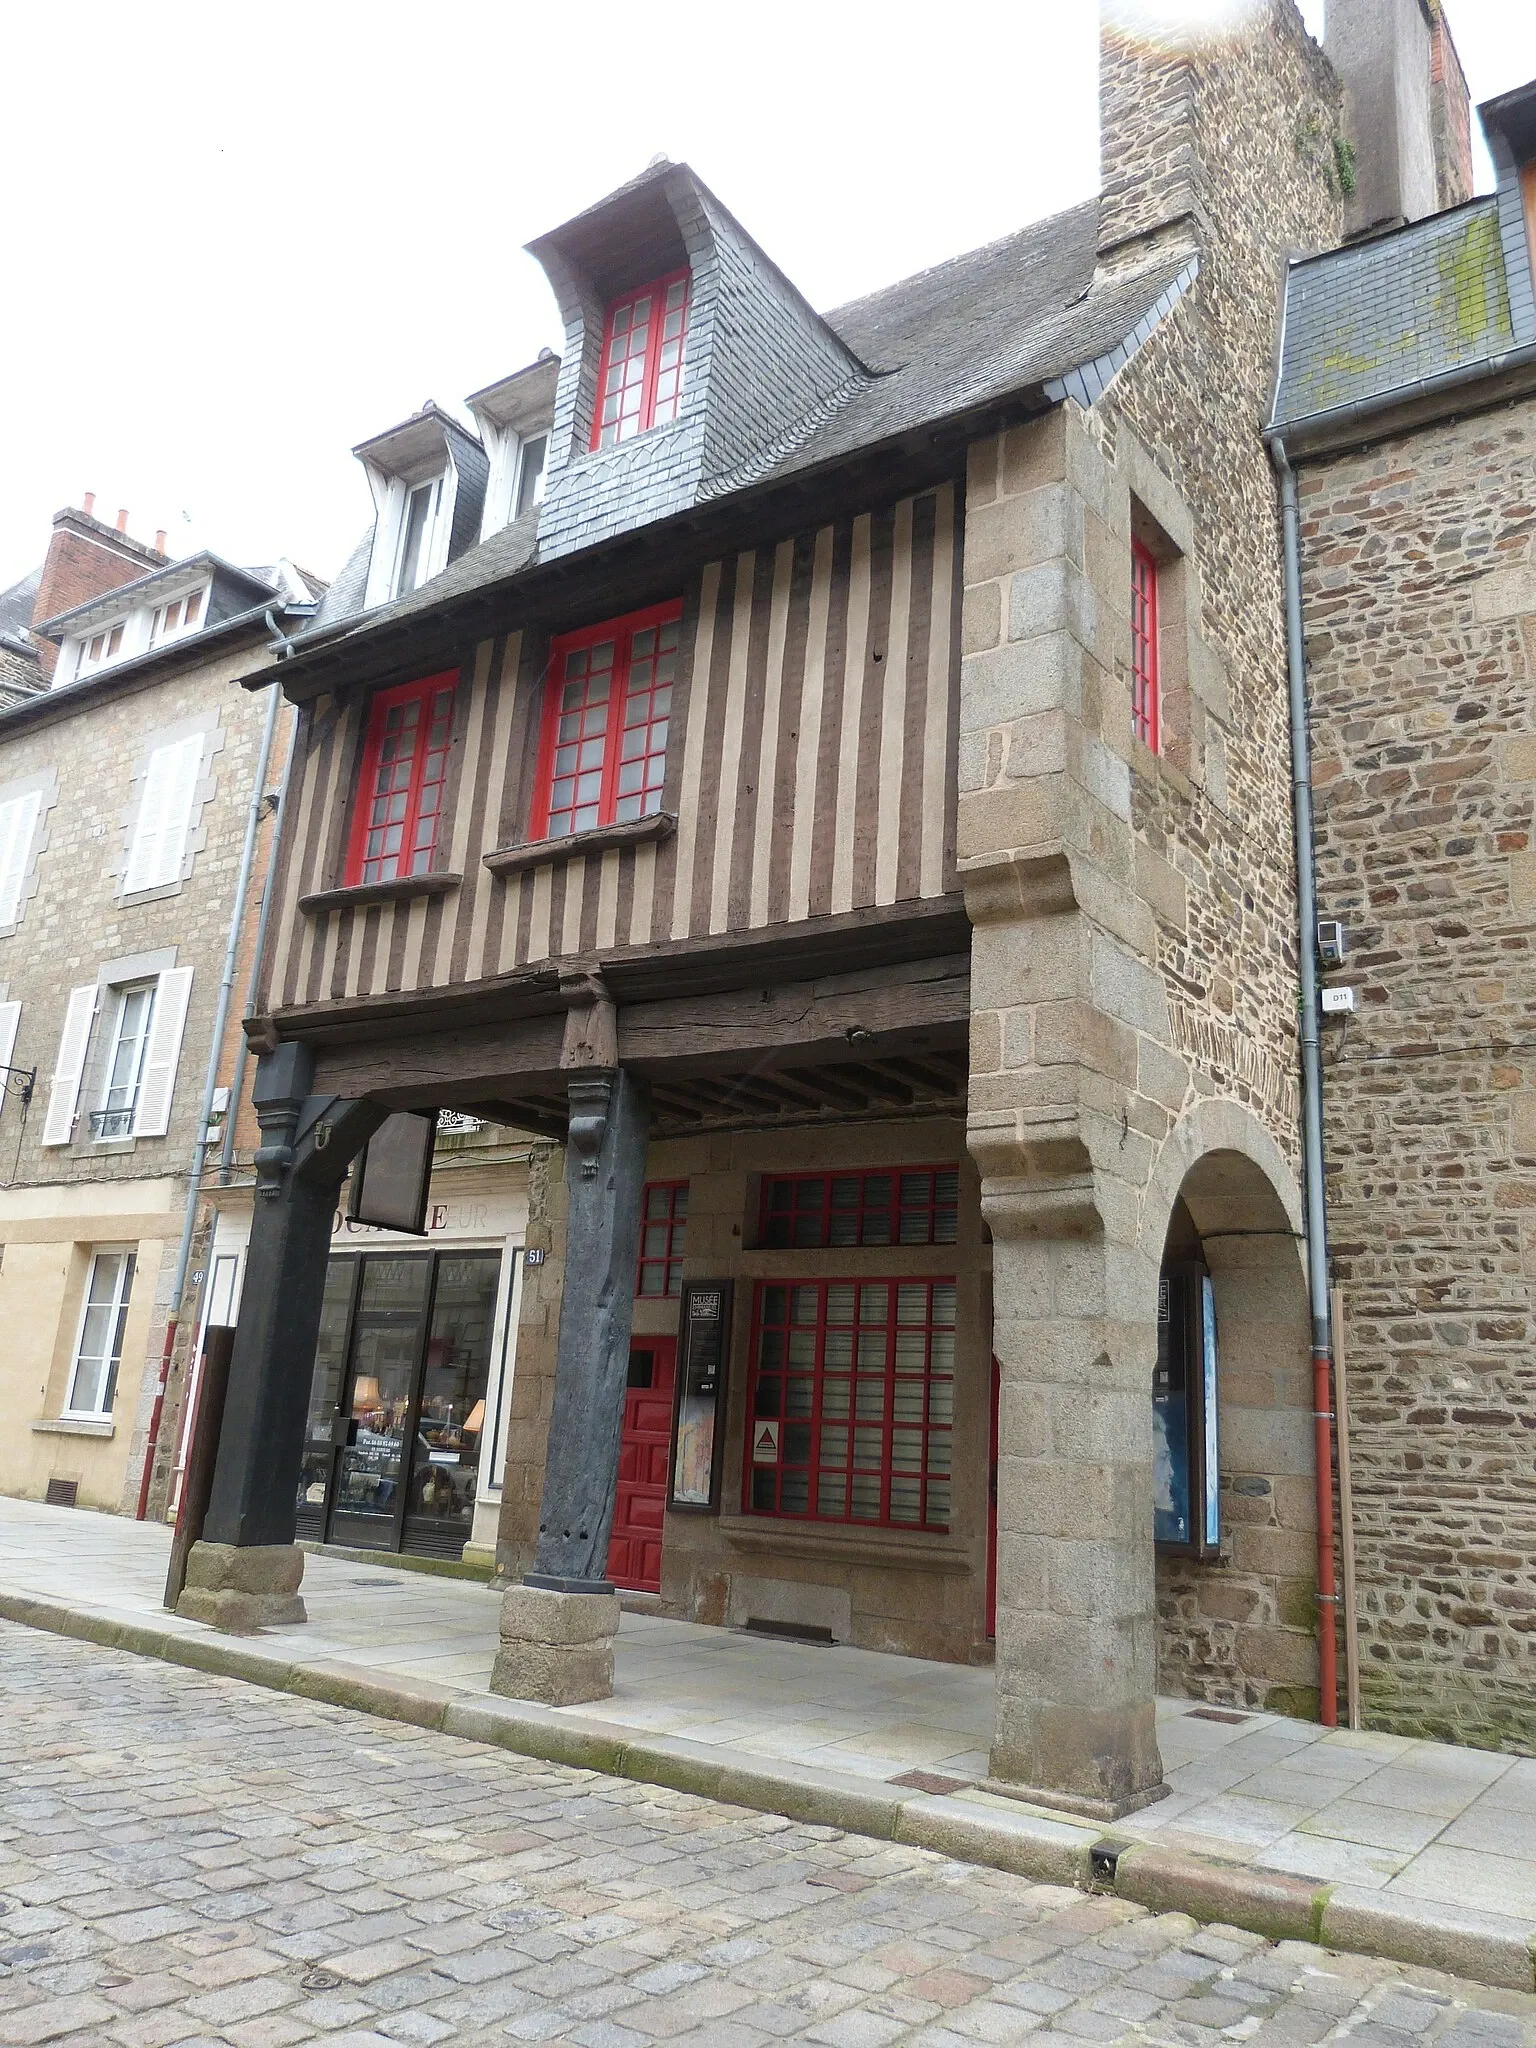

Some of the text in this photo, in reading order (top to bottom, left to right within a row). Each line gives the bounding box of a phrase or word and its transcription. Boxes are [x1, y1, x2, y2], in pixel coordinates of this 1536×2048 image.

[1333, 994, 1347, 1002] D11
[529, 1249, 540, 1263] 51
[193, 1271, 204, 1283] 49
[692, 1294, 718, 1306] MUSÉE
